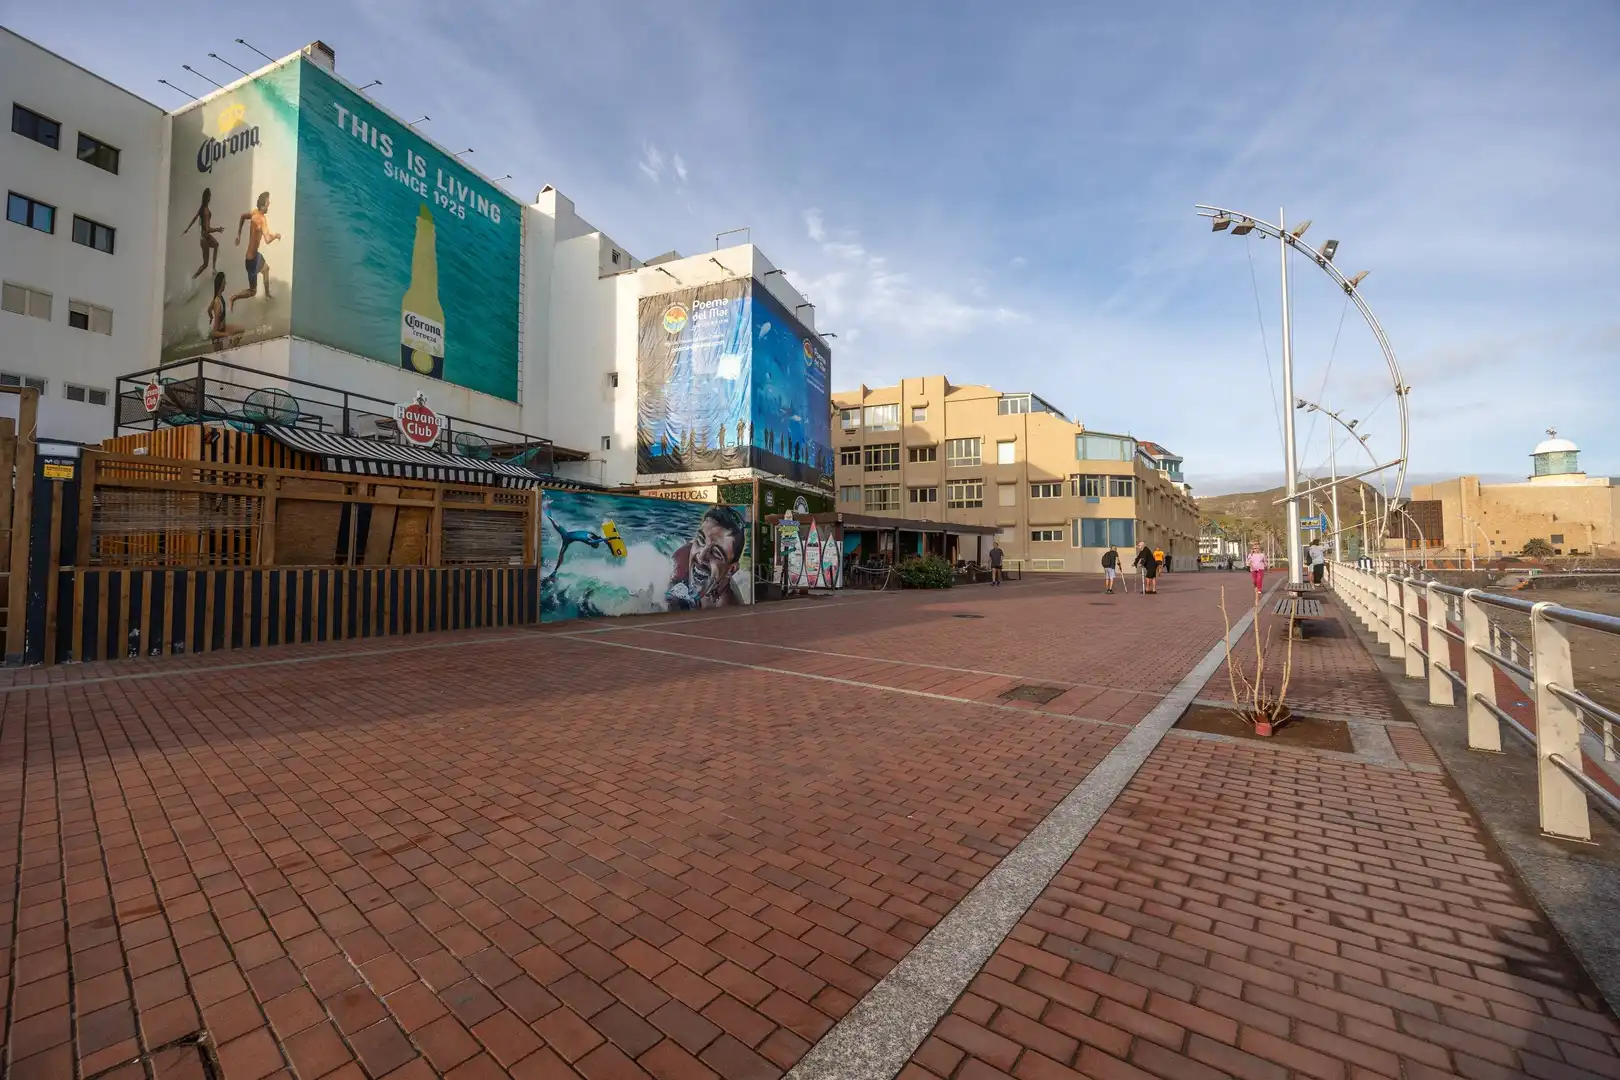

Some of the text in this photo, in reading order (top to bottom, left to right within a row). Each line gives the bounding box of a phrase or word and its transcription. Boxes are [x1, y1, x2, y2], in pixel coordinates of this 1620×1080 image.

[197, 125, 260, 174] Corona
[333, 102, 501, 224] THIS IS LIVING
[383, 161, 466, 220] SINCE 1925
[692, 297, 729, 311] Poema
[692, 307, 728, 321] del Mar
[405, 313, 441, 337] Corona
[397, 405, 441, 426] Havana
[407, 422, 432, 437] Club
